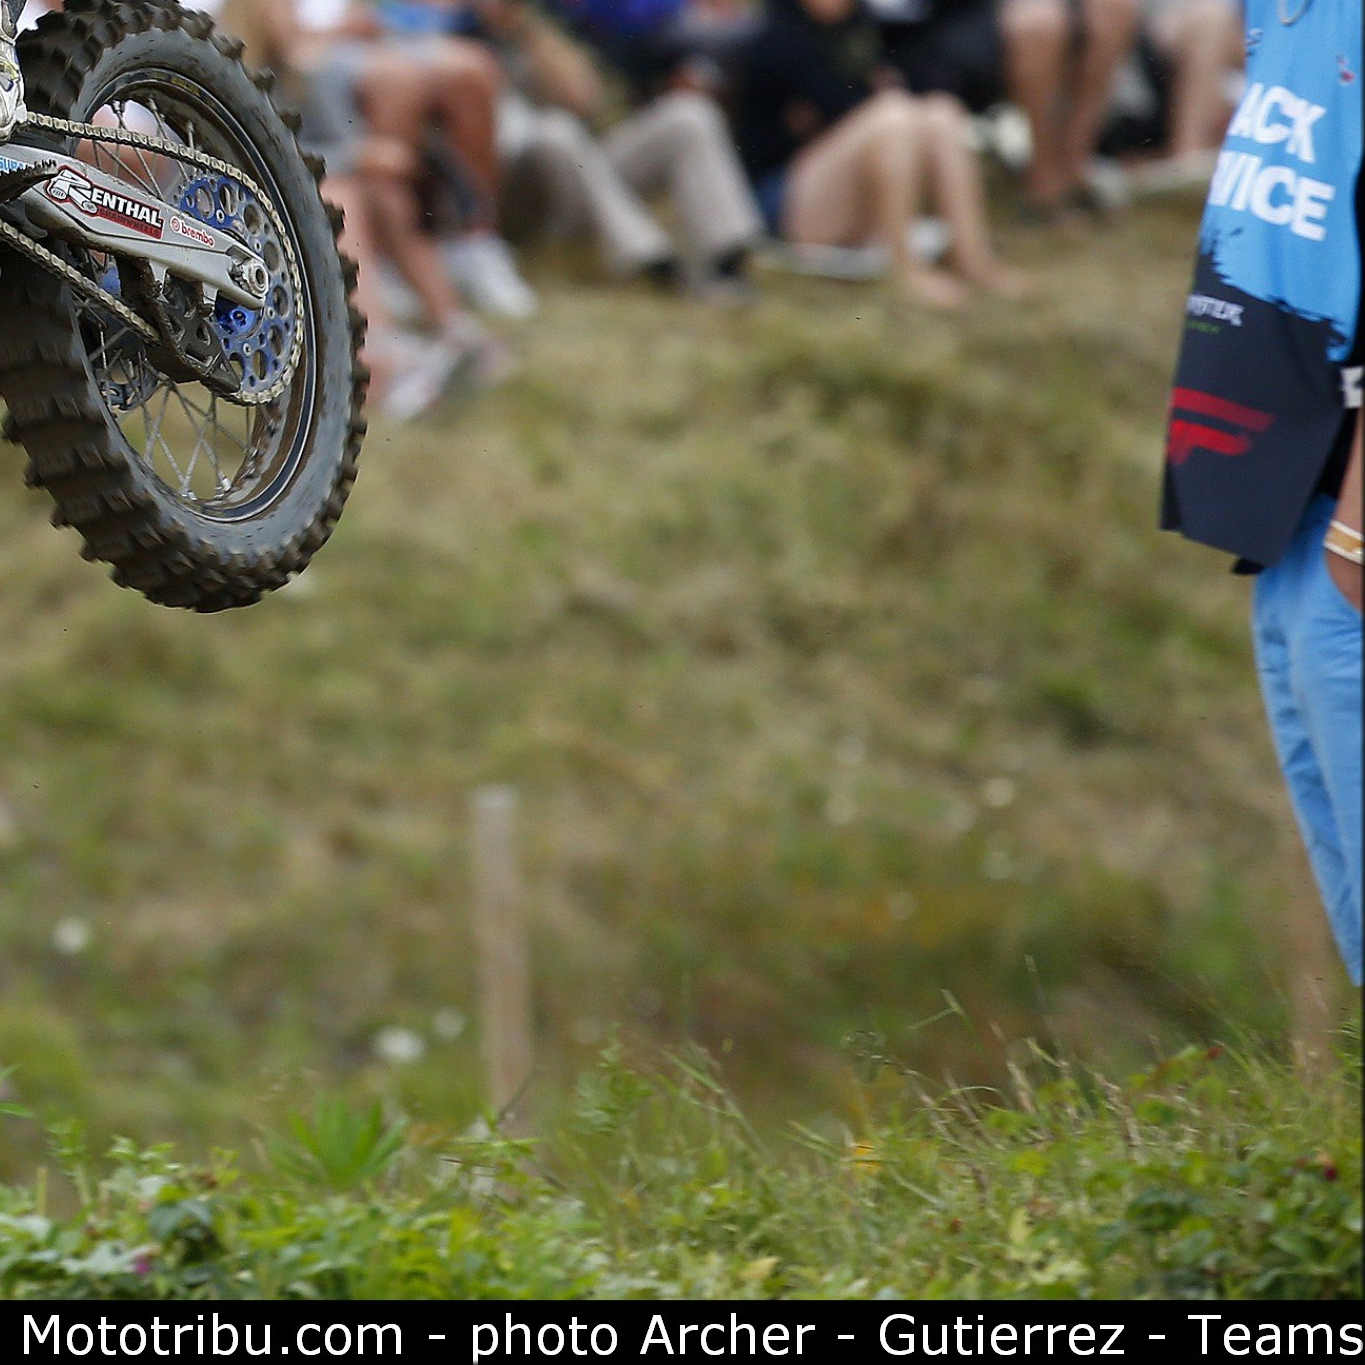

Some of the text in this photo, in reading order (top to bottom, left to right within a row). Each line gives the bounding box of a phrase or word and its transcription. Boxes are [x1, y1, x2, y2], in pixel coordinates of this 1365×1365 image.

[1226, 82, 1327, 164] ACK
[180, 224, 215, 247] brembo
[1207, 149, 1337, 242] VICE
